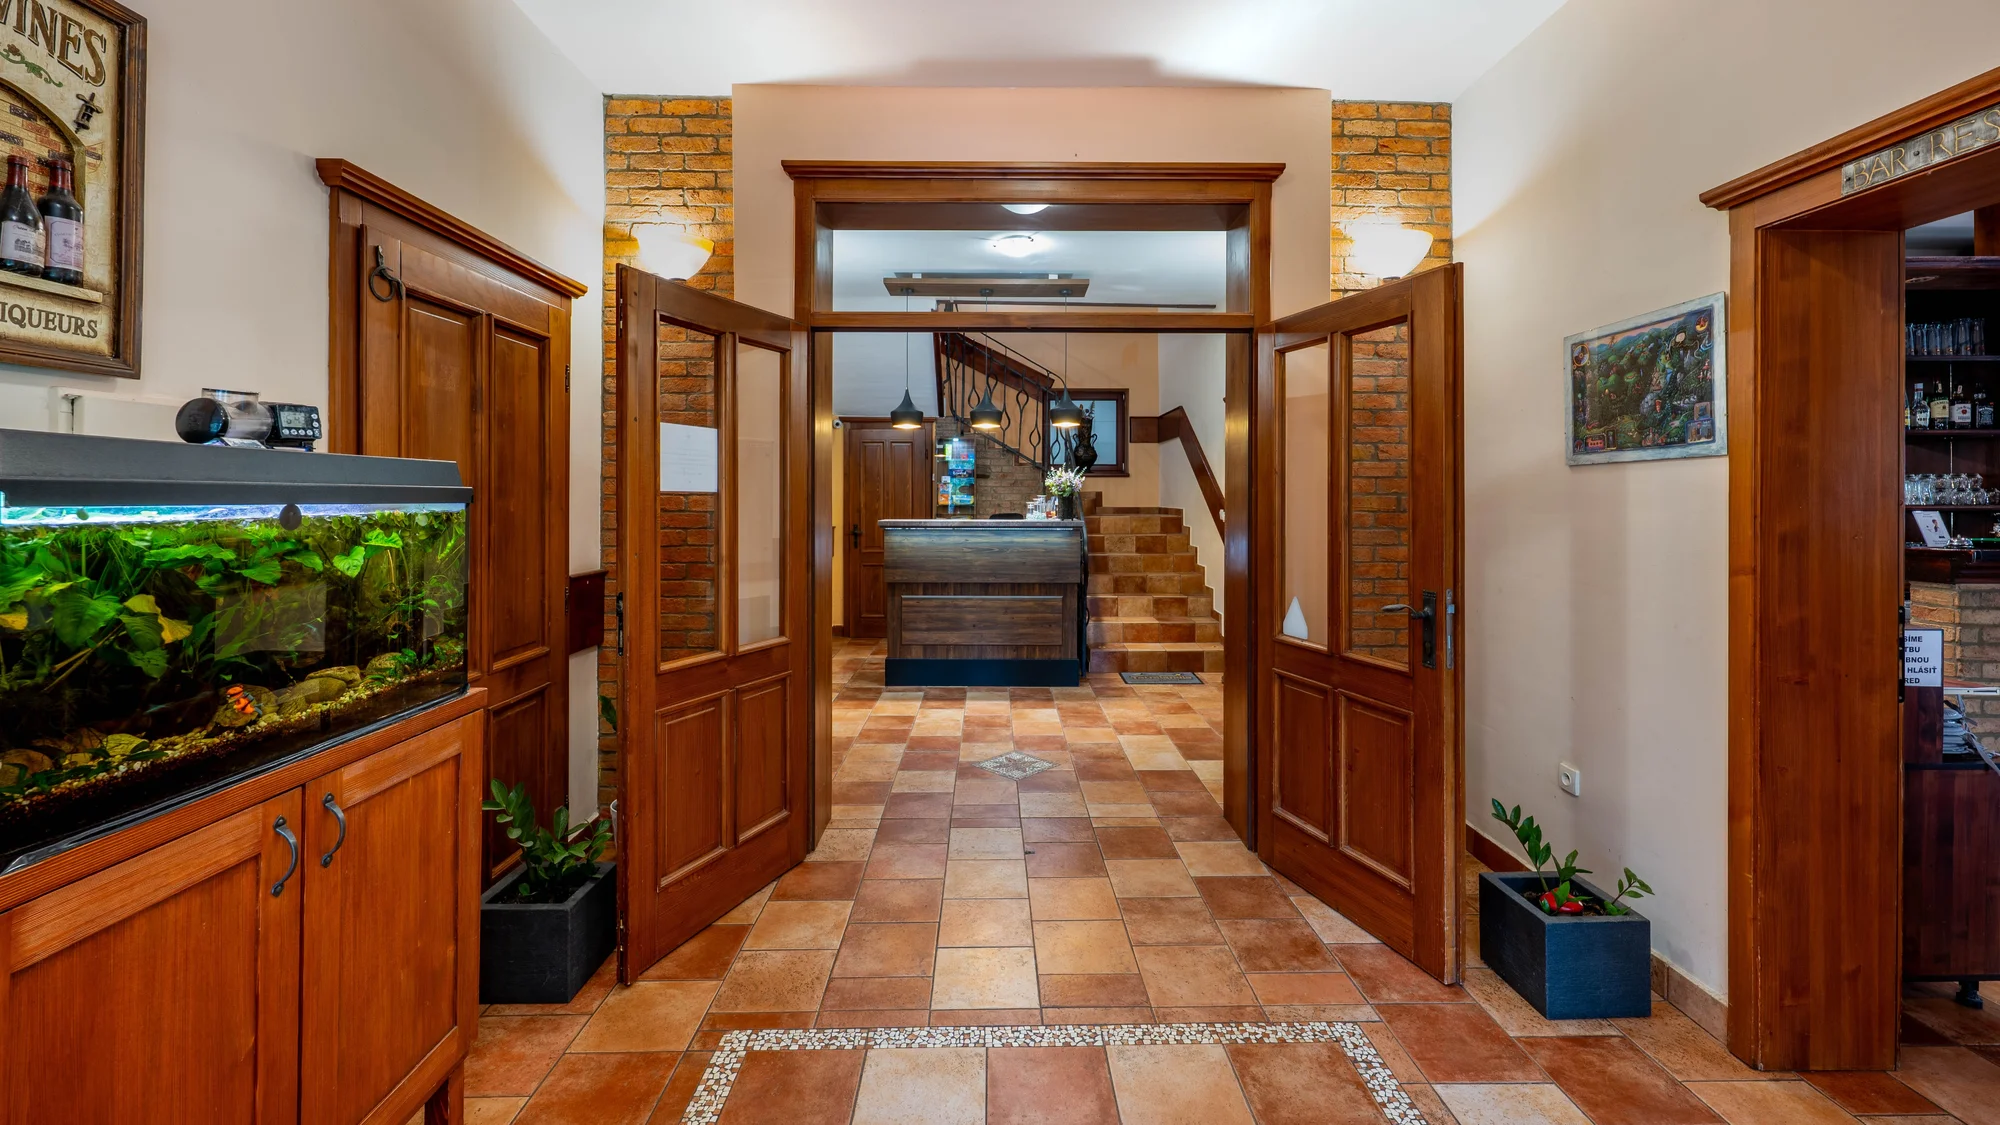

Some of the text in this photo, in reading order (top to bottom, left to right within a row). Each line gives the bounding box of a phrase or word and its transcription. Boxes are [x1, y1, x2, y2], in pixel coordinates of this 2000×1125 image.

[1852, 109, 2000, 189] BAR RES
[1907, 666, 1937, 674] HLÁSIŤ
